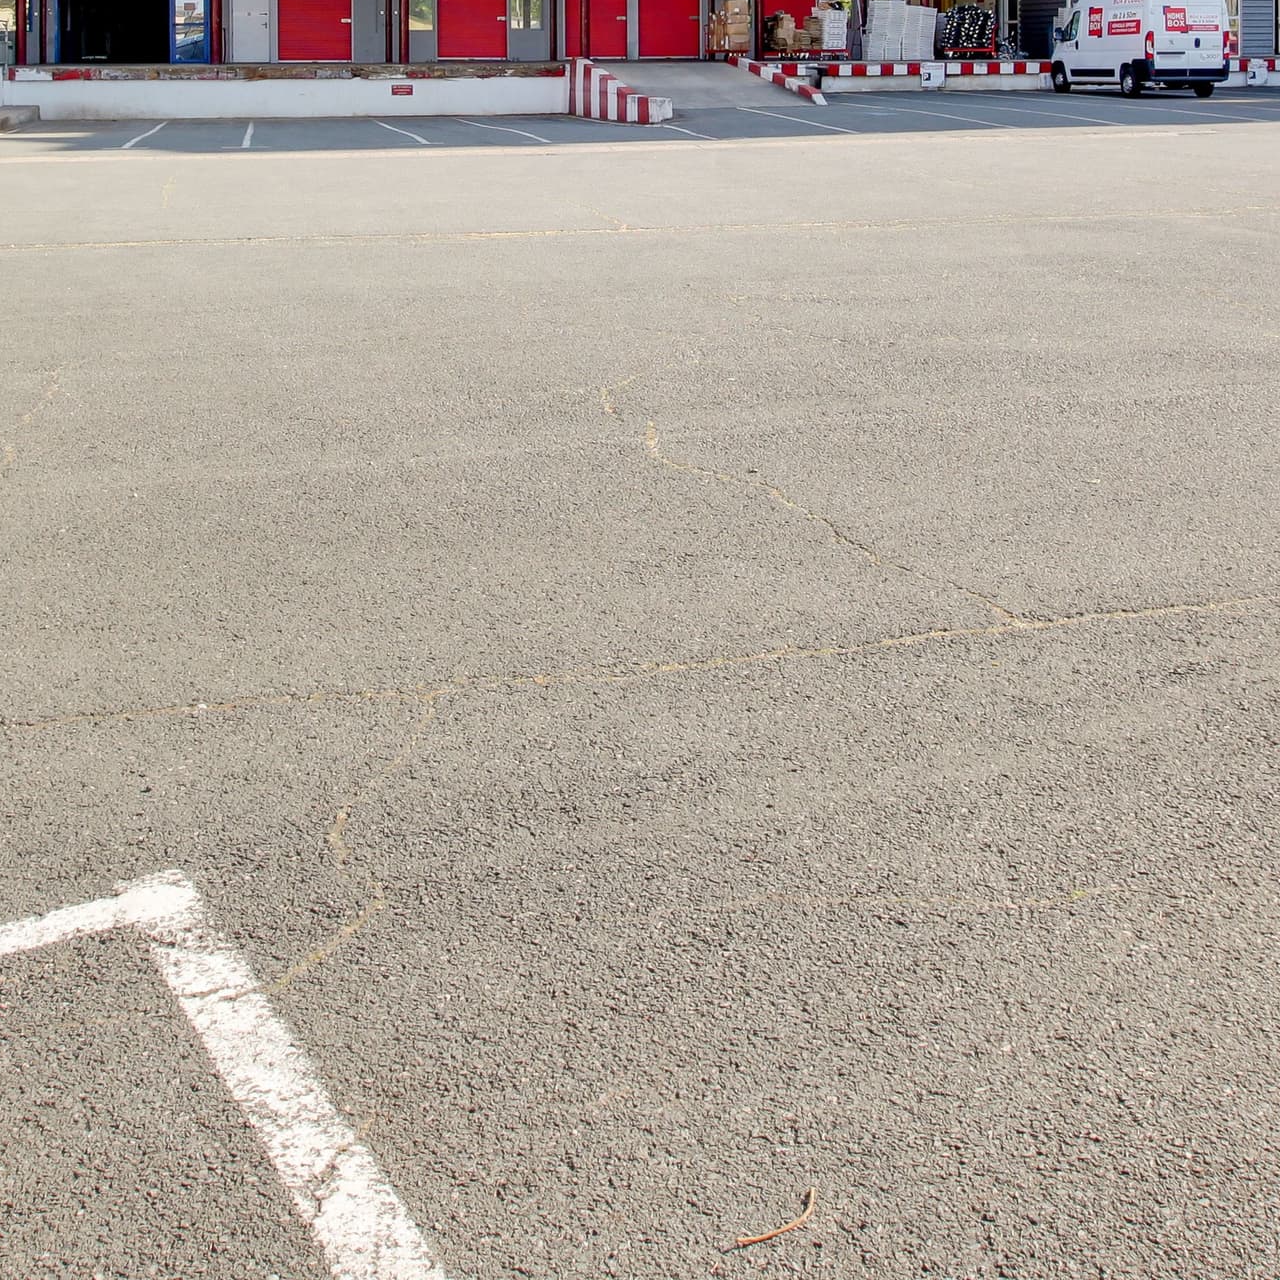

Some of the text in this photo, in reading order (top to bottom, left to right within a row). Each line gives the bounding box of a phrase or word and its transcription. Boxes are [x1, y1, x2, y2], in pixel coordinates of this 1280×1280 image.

[1167, 12, 1185, 20] HOME
[1090, 22, 1102, 30] BOX
[1167, 19, 1185, 27] BOX
